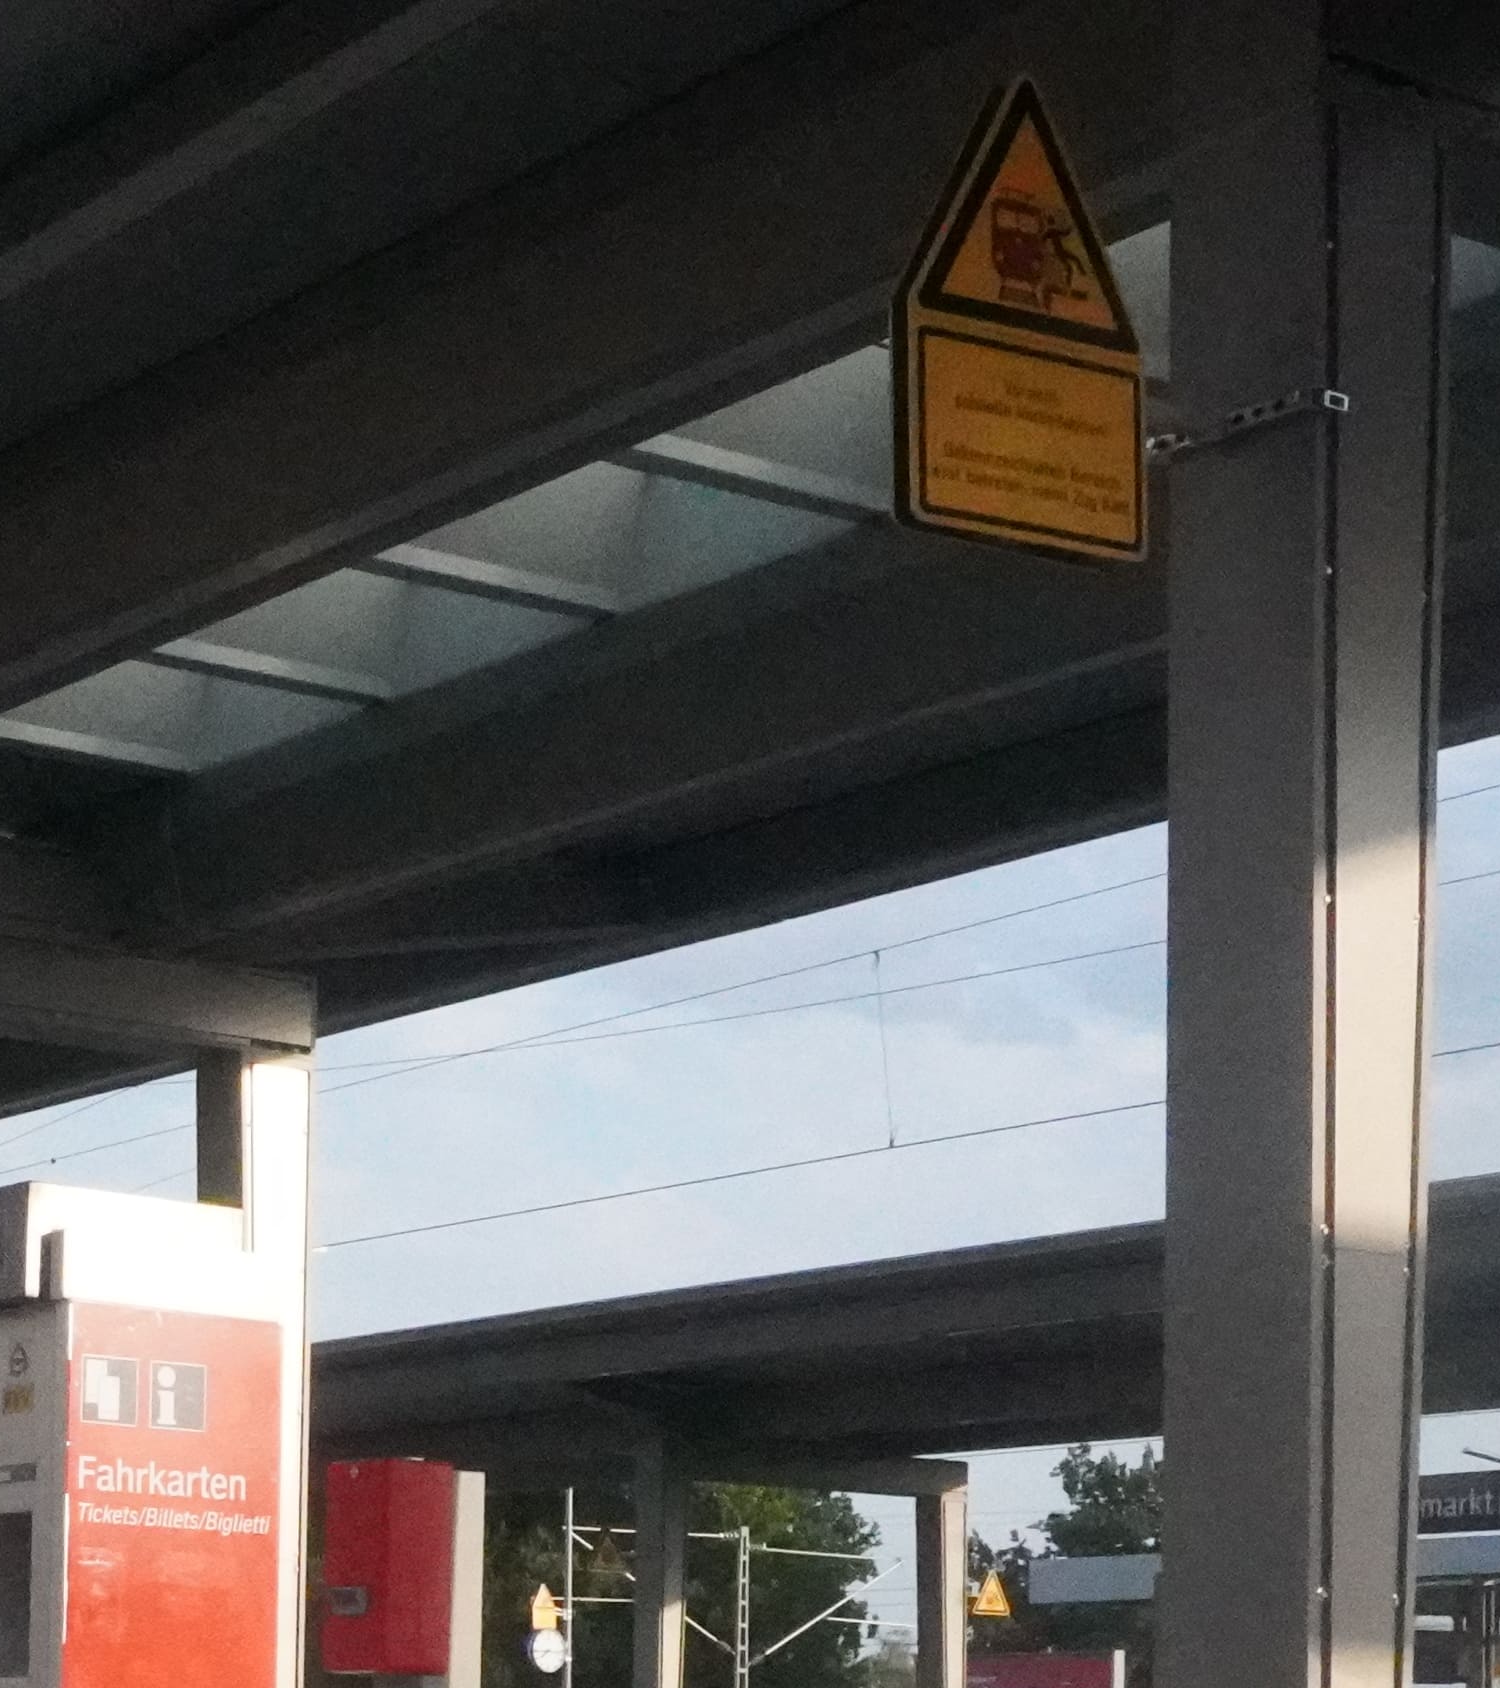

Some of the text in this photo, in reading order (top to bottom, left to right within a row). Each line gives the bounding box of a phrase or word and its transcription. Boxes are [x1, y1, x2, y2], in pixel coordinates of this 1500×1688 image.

[77, 1455, 247, 1501] Fahrkarten
[78, 1502, 272, 1537] Tickets/Billets/Biglietti
[1419, 1487, 1495, 1518] markt
